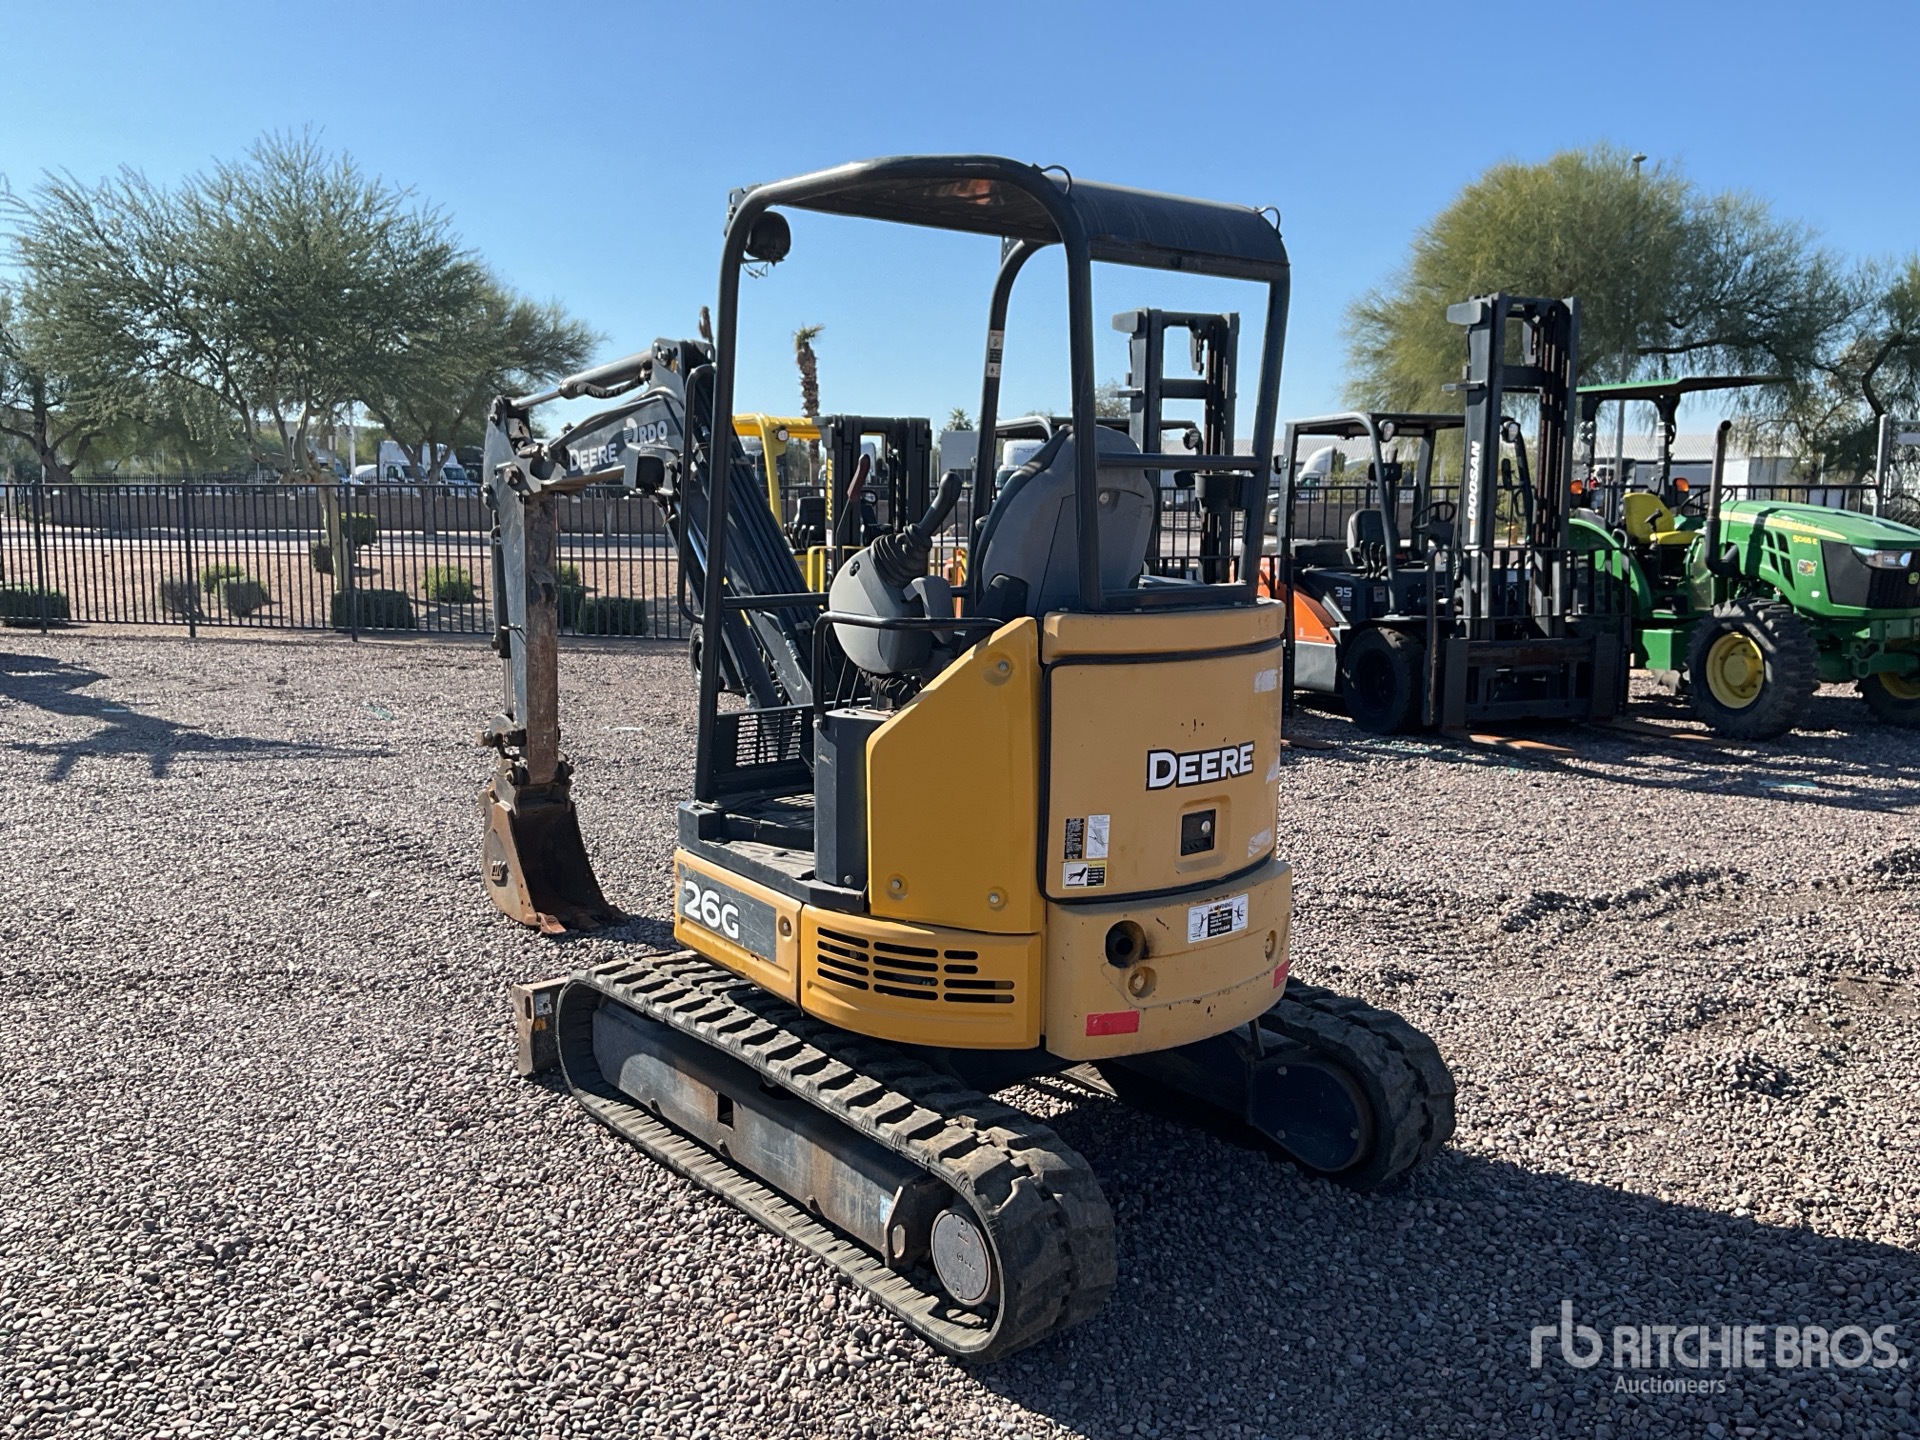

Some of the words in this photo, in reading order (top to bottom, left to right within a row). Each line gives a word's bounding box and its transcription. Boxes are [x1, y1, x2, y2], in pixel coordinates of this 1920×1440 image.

[569, 443, 618, 472] DEERE
[1467, 440, 1481, 521] DOOSAN
[1334, 586, 1353, 598] 35
[1148, 743, 1254, 788] DEERE
[684, 880, 739, 940] 26G
